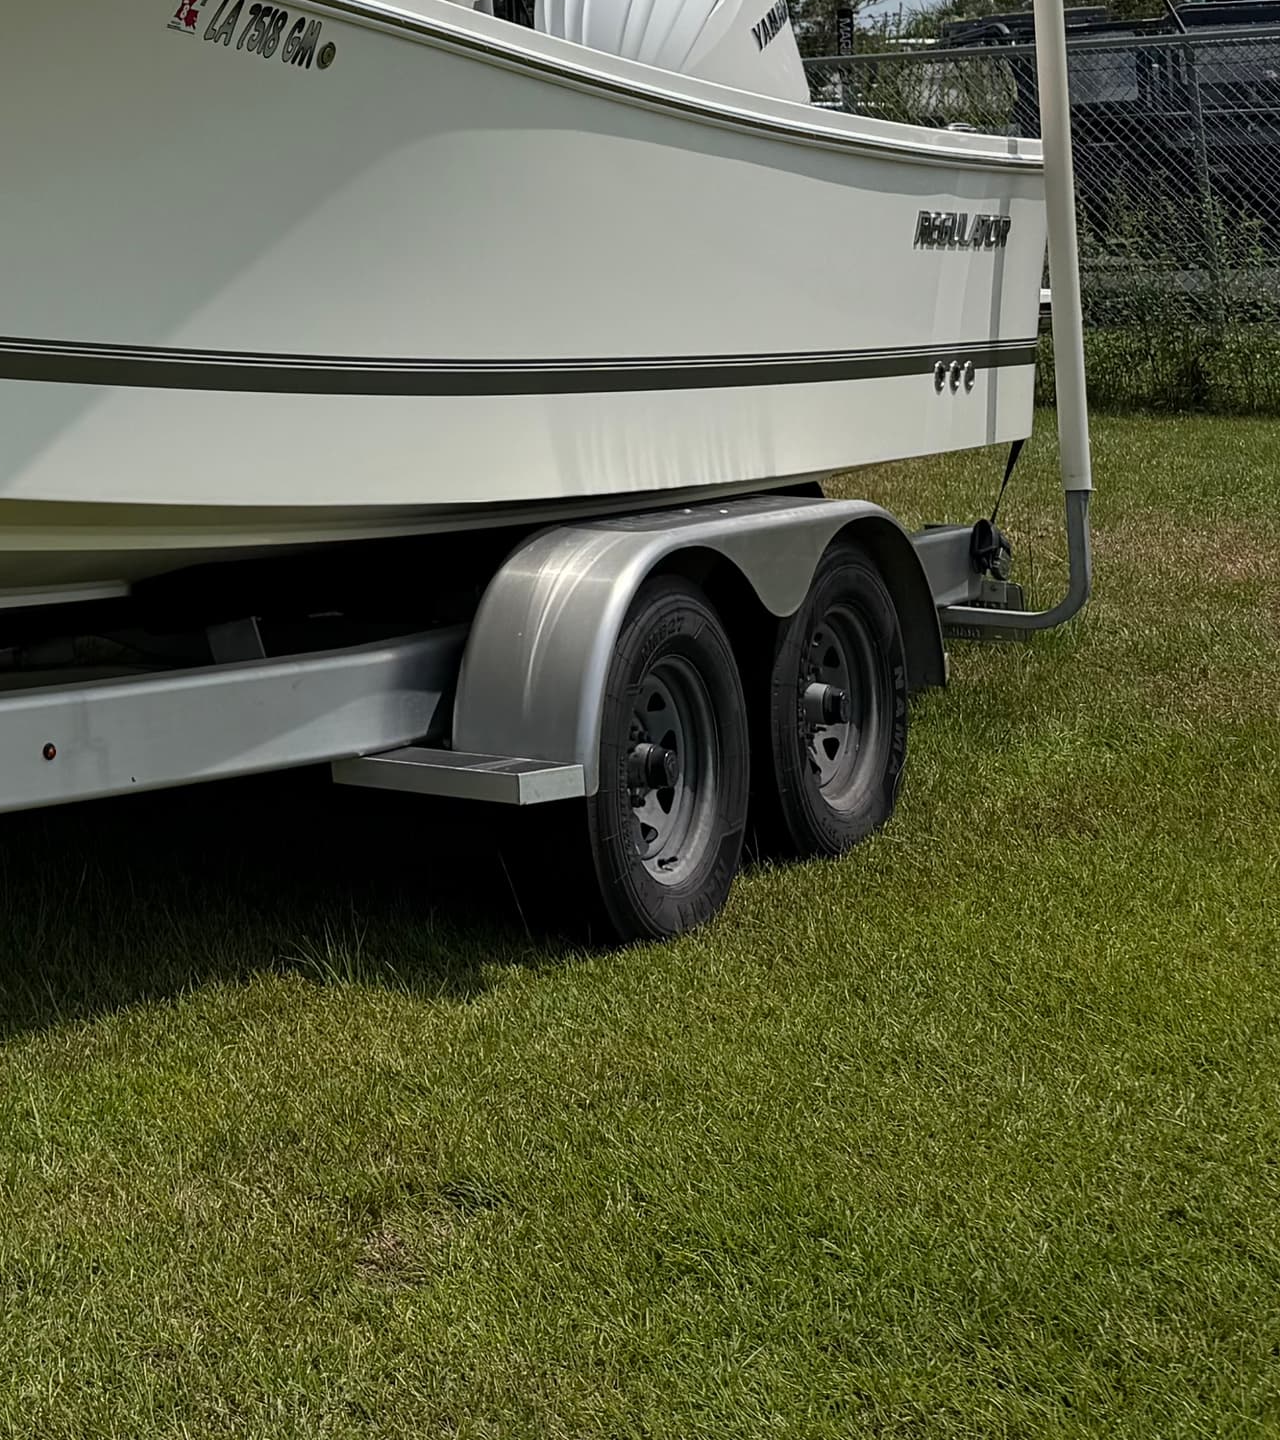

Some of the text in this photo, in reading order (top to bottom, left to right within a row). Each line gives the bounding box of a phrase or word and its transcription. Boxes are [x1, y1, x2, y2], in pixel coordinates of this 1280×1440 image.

[237, 3, 288, 58] 7518
[282, 17, 322, 69] GM
[913, 211, 1011, 250] REGULATOR
